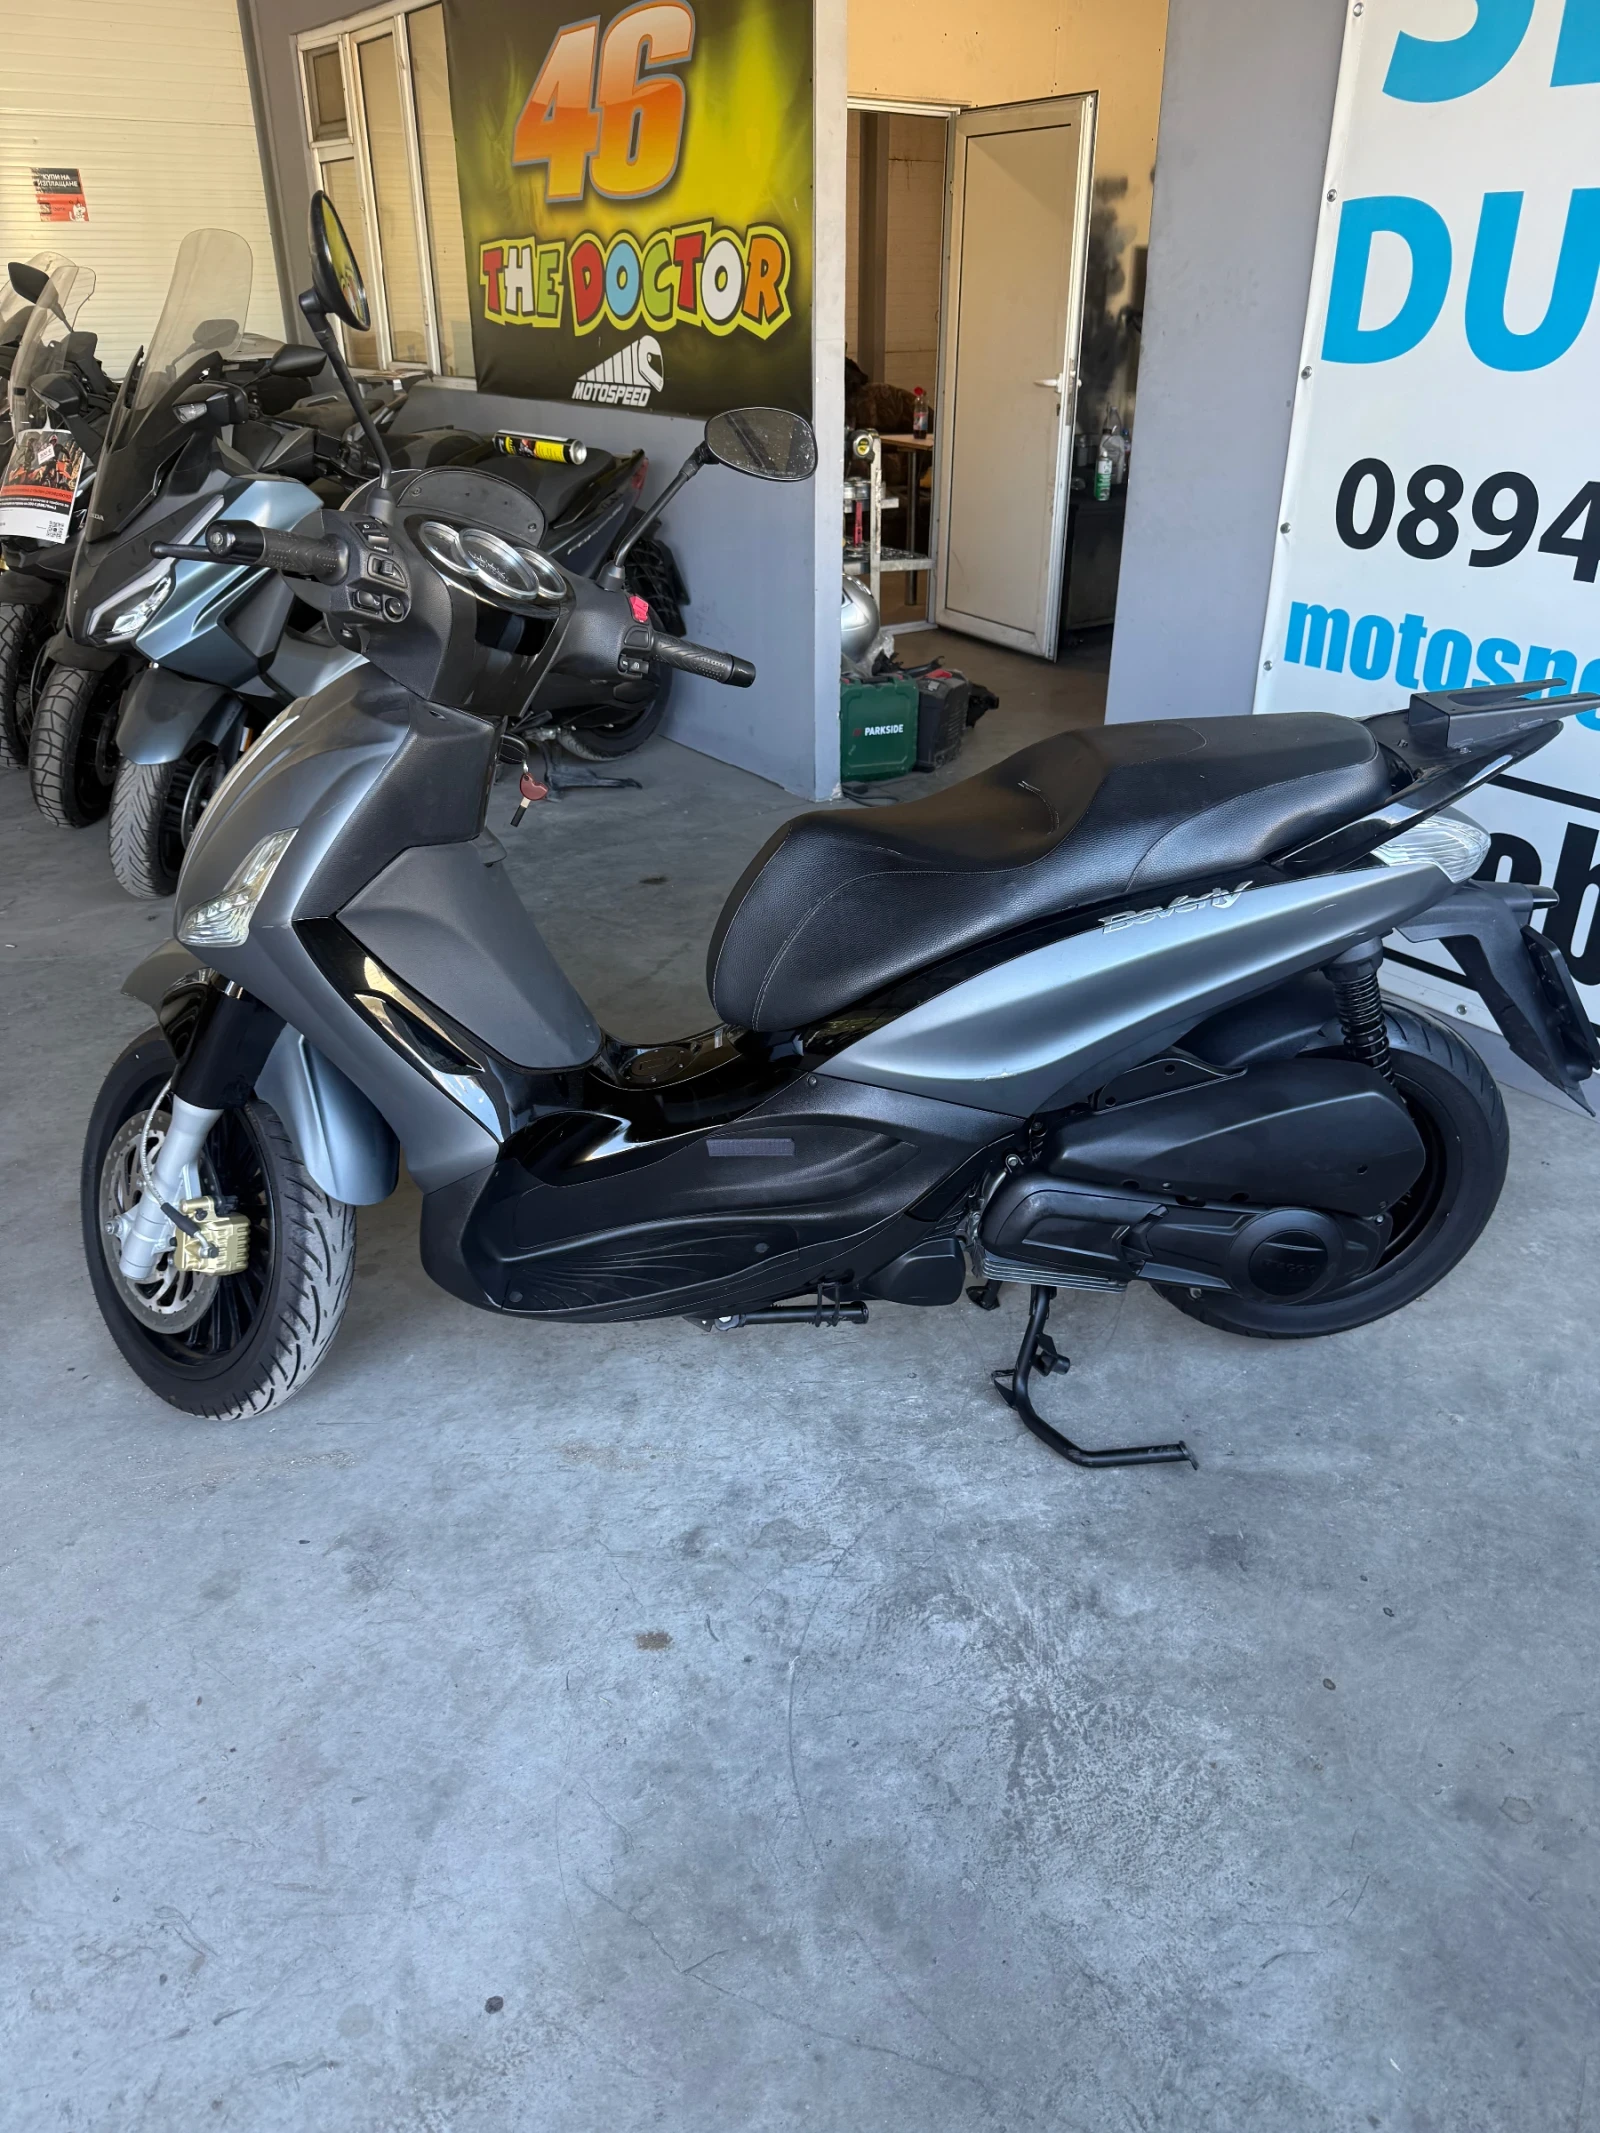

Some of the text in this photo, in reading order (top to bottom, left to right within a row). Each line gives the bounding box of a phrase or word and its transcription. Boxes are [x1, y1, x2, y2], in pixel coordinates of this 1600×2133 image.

[512, 0, 696, 203] 46
[481, 227, 788, 333] THE DOCTOR
[572, 381, 651, 407] MOTOSPEED
[1335, 457, 1600, 583] 0894
[864, 724, 904, 736] PARKSIDE
